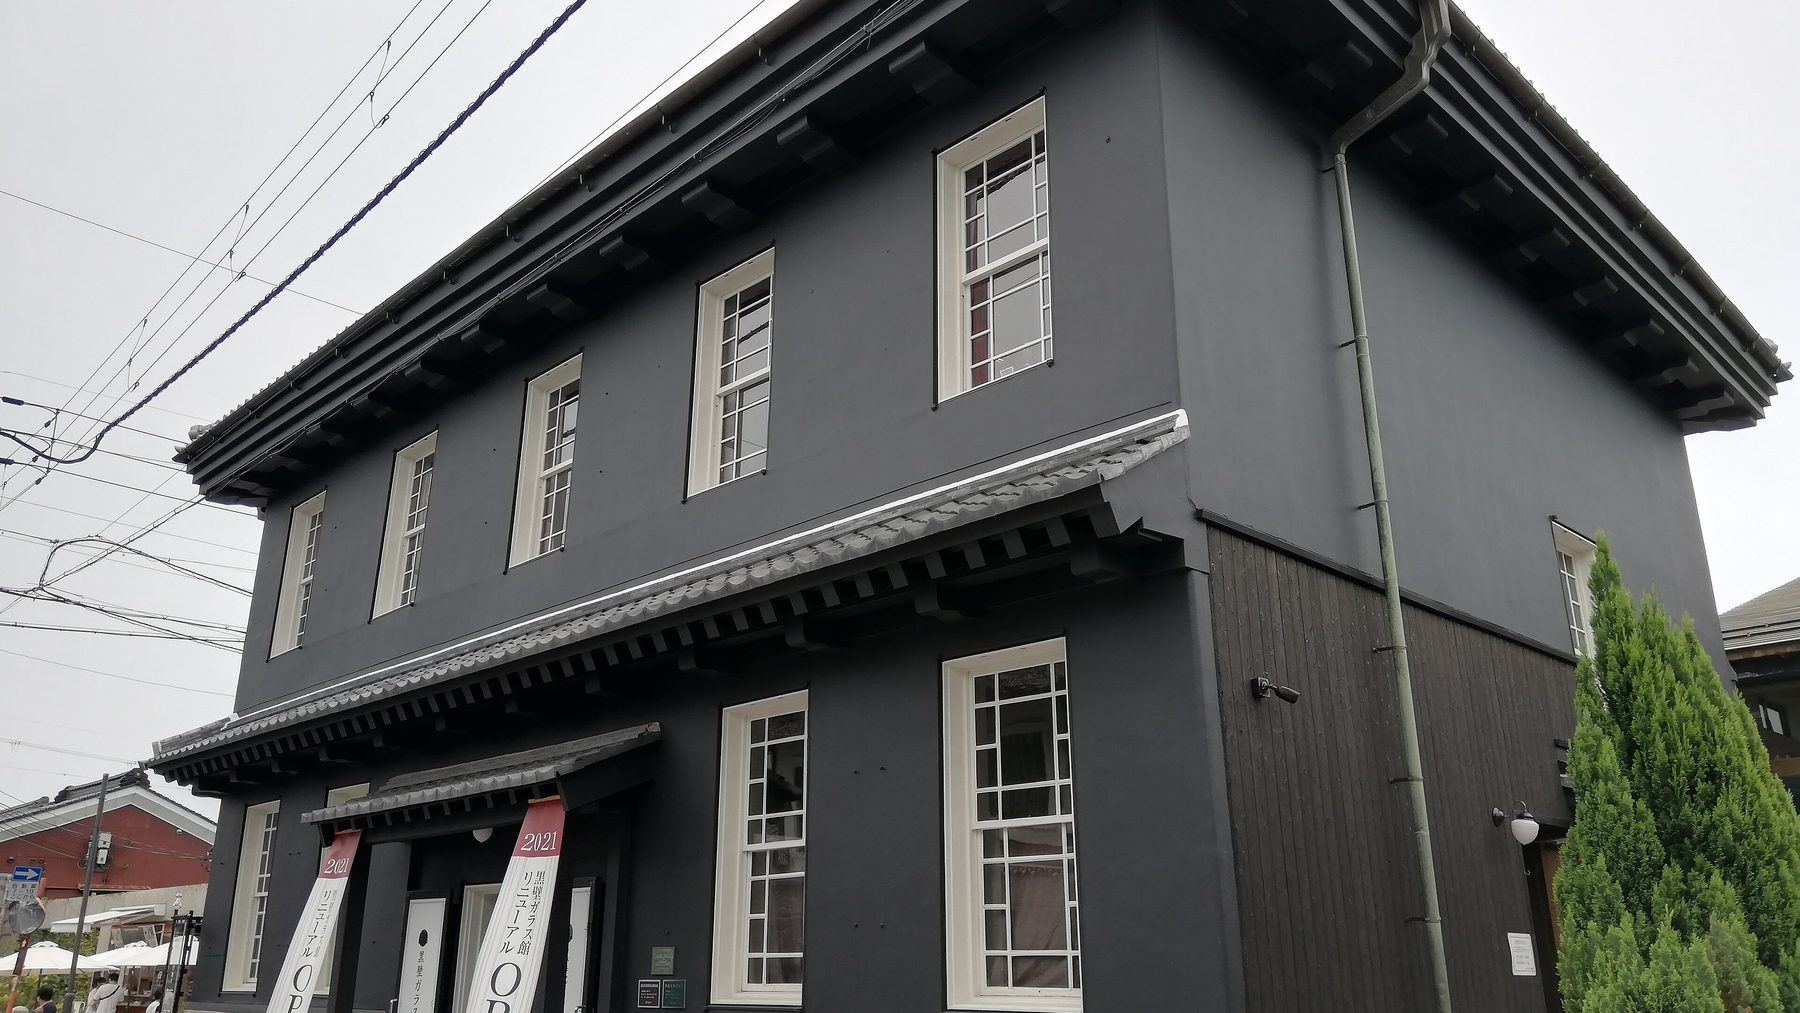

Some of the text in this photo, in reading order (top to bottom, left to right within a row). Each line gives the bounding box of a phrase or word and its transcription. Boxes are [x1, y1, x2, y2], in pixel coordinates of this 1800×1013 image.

[323, 857, 350, 874] 2021
[520, 831, 557, 851] 2021
[301, 889, 332, 958] リニューアル
[499, 871, 533, 954] リニューアル
[516, 871, 546, 956] 黒壁ガラス館
